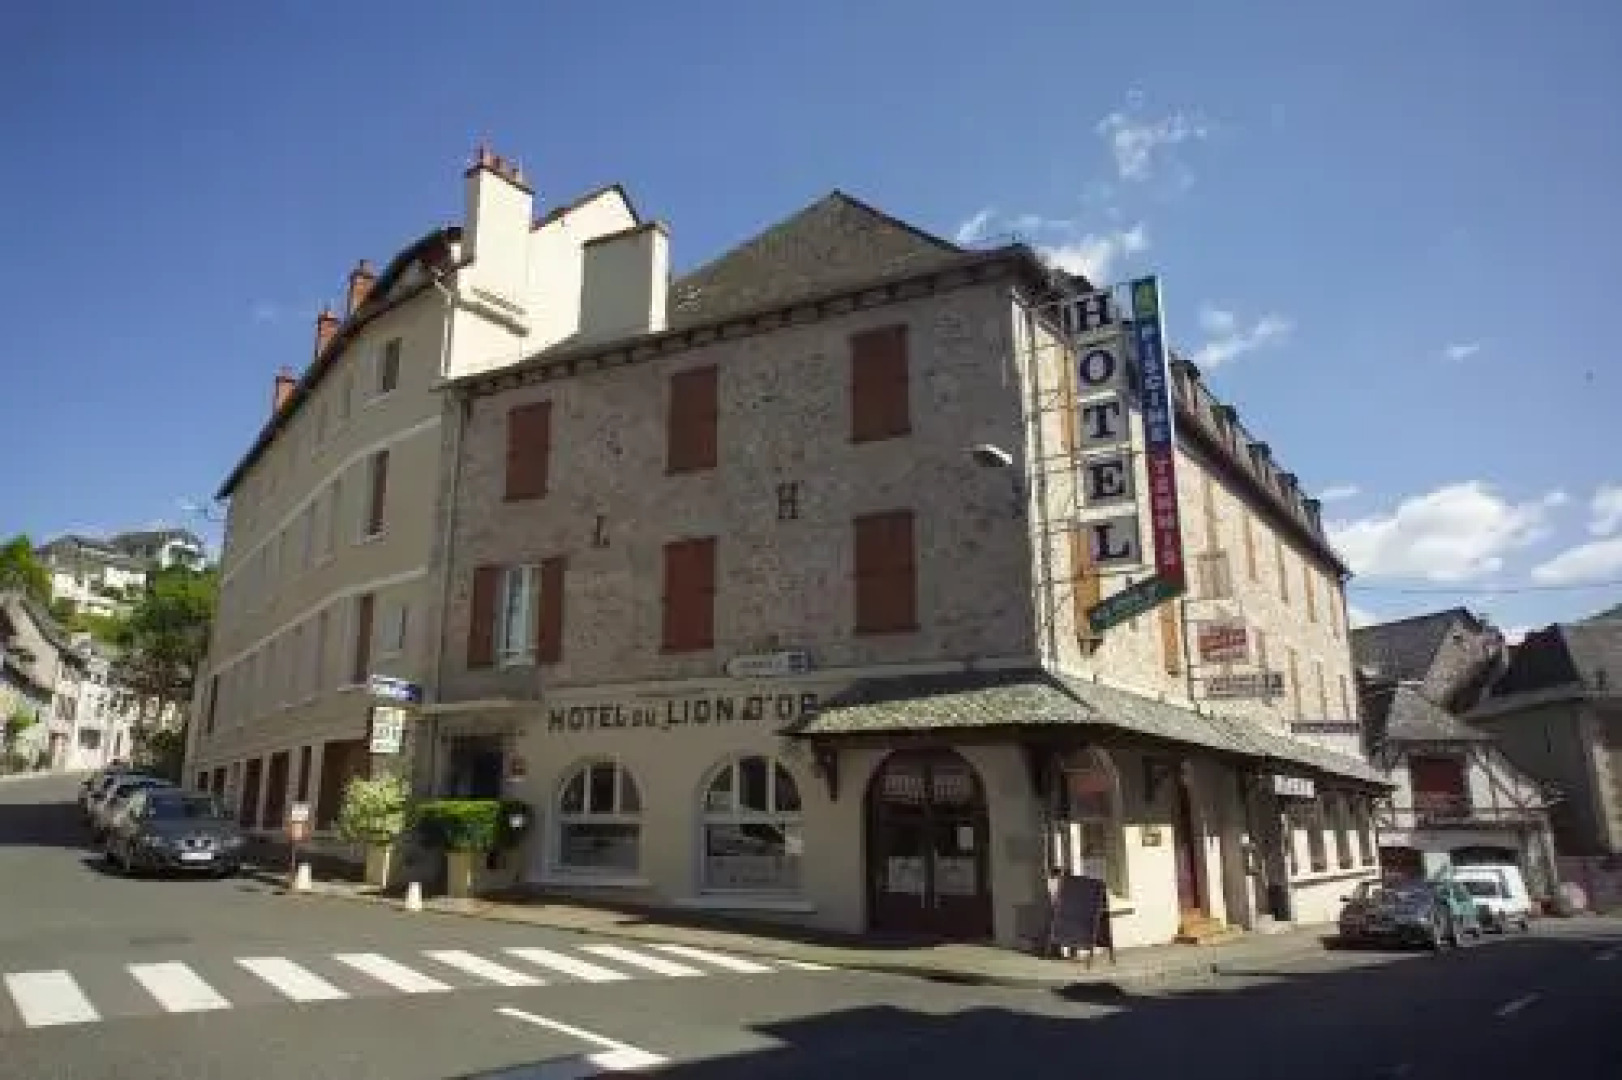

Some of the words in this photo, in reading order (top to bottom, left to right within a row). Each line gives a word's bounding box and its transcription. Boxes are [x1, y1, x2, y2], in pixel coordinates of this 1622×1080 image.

[1077, 294, 1130, 562] HOTEL
[1141, 325, 1165, 442] PISCINE
[1154, 459, 1176, 566] TENNIS
[664, 698, 735, 728] LION
